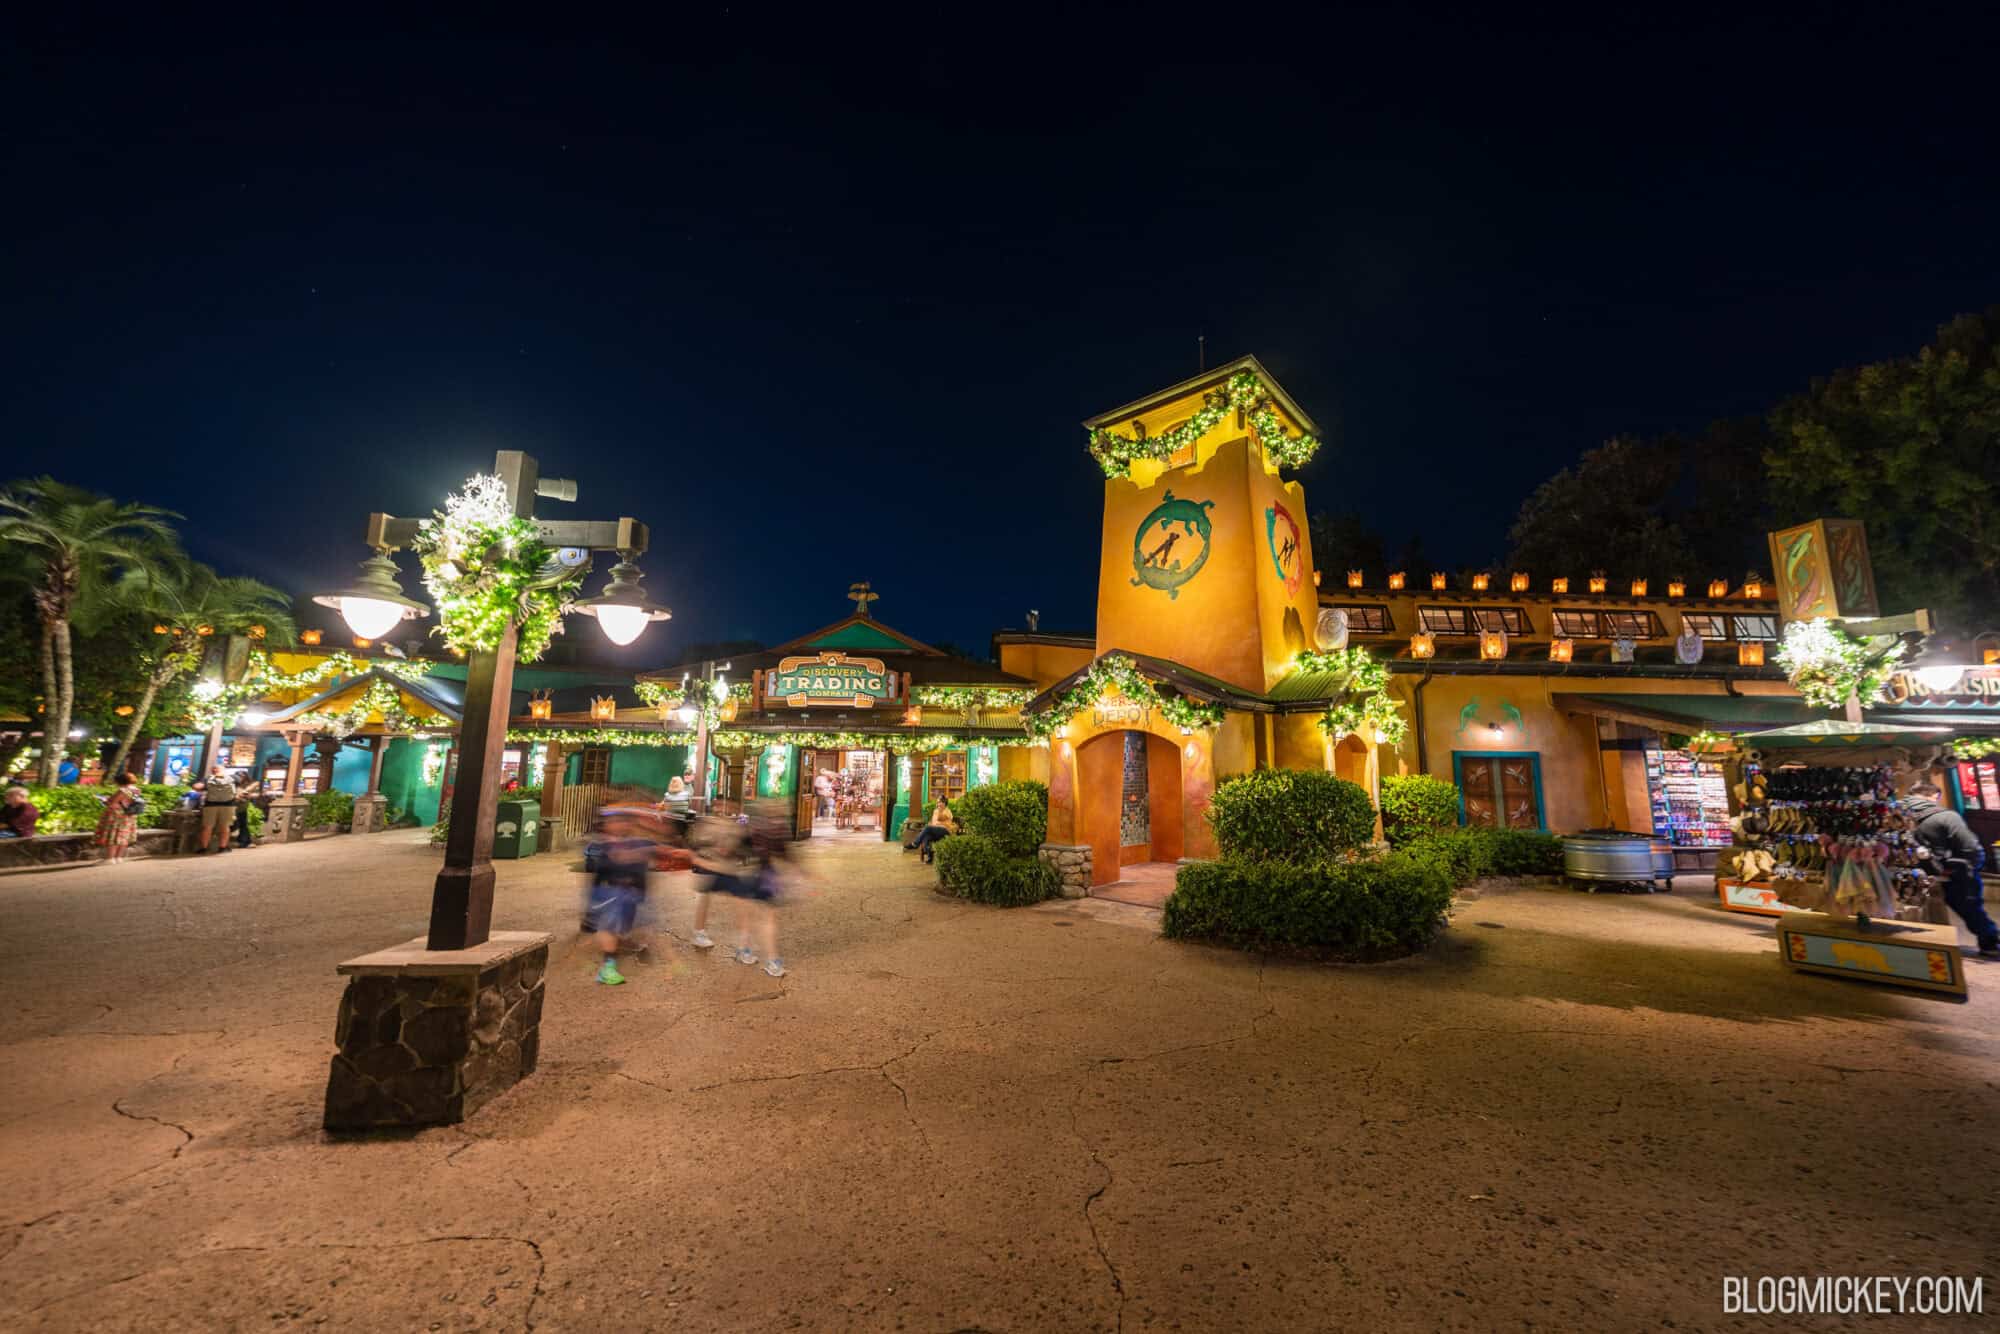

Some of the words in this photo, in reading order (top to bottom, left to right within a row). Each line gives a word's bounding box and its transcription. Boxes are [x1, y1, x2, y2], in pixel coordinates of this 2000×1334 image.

[802, 668, 864, 677] DISCOVERY
[783, 677, 882, 690] TRADING
[1906, 670, 2000, 697] RRSID
